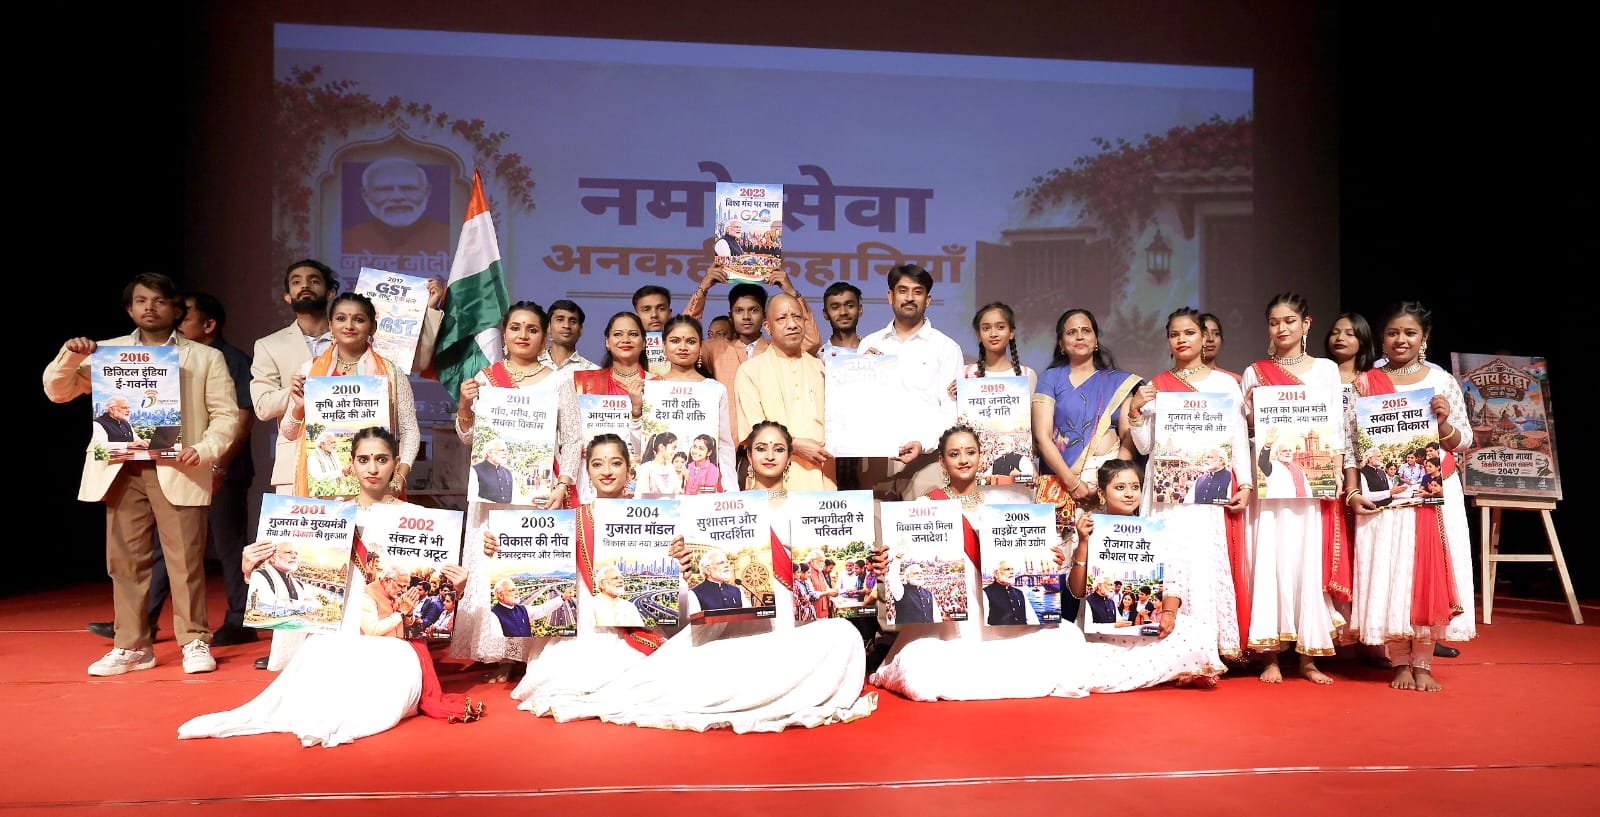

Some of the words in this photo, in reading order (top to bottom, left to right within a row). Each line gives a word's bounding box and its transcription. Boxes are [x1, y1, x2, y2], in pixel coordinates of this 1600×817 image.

[739, 187, 766, 198] 2023
[753, 200, 762, 208] पर
[764, 200, 780, 209] भारत
[387, 276, 404, 284] 2017
[375, 282, 412, 297] GST
[379, 316, 418, 336] GST
[646, 336, 660, 345] 24
[120, 352, 150, 362] 2016
[103, 366, 139, 377] डिजिटल
[142, 366, 167, 378] इंडिया
[1471, 373, 1500, 386] चाय
[331, 384, 361, 395] 2010
[670, 385, 693, 395] 2012
[980, 383, 1005, 393] 2019
[506, 394, 530, 405] 2011
[967, 397, 986, 406] नया
[988, 394, 1020, 405] जनादेश
[1278, 390, 1306, 401] 2014
[315, 398, 334, 411] कृषि
[352, 397, 379, 407] किसान
[602, 399, 627, 408] 2018
[661, 397, 678, 408] नारी
[680, 397, 701, 409] शक्ति
[1183, 399, 1208, 409] 2013
[1259, 406, 1278, 414] भारत
[1292, 405, 1310, 413] प्रधान
[1311, 402, 1327, 413] मंत्री
[1382, 397, 1408, 409] 2015
[321, 409, 346, 422] समृद्धि
[347, 408, 359, 418] की
[587, 412, 622, 422] आयुष्मान
[655, 408, 670, 420] देश
[672, 409, 684, 420] की
[686, 409, 706, 421] शक्ति
[978, 405, 992, 418] नई
[994, 405, 1011, 416] गति
[1167, 413, 1192, 422] गुजरात
[1193, 411, 1201, 421] से
[1202, 411, 1223, 421] दिल्ली
[1369, 411, 1399, 424] सबका
[1402, 408, 1424, 419] साथ
[518, 418, 545, 430] विकास
[1259, 414, 1270, 424] नई
[1311, 415, 1328, 423] भारत
[1185, 422, 1203, 434] नेतृत्व
[1204, 422, 1214, 432] की
[1366, 423, 1395, 436] सबका
[1397, 419, 1430, 433] विकास
[1477, 450, 1497, 460] नमो
[1499, 450, 1514, 460] सेवा
[290, 504, 327, 515] 2001
[714, 499, 744, 511] 2005
[818, 499, 847, 510] 2006
[626, 506, 660, 518] 2004
[908, 506, 938, 517] 2007
[1005, 512, 1030, 522] 2008
[269, 517, 299, 528] गुजरात
[300, 516, 309, 527] के
[310, 518, 347, 530] मुख्यमंत्री
[398, 516, 435, 531] 2002
[521, 516, 555, 529] 2003
[696, 515, 735, 532] सुशासन
[738, 511, 758, 524] और
[801, 511, 855, 525] जनभागीदारी
[855, 511, 864, 522] से
[605, 523, 642, 537] गुजरात
[644, 521, 676, 535] मॉडल
[814, 523, 853, 537] परिवर्तन
[896, 521, 922, 532] विकास
[923, 520, 935, 531] को
[935, 519, 953, 531] मिला
[1019, 526, 1047, 537] गुजरात
[1113, 523, 1142, 534] 2009
[266, 528, 278, 537] सेवा
[279, 528, 291, 537] और
[292, 529, 314, 538] विकास
[314, 530, 323, 539] की
[388, 531, 417, 544] संकट
[418, 533, 429, 545] में
[430, 534, 444, 547] भी
[710, 525, 755, 541] पारदर्शिता
[498, 532, 533, 547] विकास
[535, 532, 548, 547] की
[550, 532, 570, 547] नींव
[602, 537, 626, 547] विकास
[994, 537, 1013, 548] निवेश
[1015, 537, 1027, 547] और
[1028, 537, 1046, 547] उद्योग
[1103, 536, 1134, 549] रोजगार
[1135, 537, 1151, 550] और
[387, 543, 421, 557] संकल्प
[423, 548, 449, 562] अटूट
[537, 548, 552, 559] और
[552, 549, 572, 559] निवेश
[1099, 548, 1127, 561] कौशल
[1128, 553, 1139, 562] पर
[1140, 551, 1155, 563] जोर
